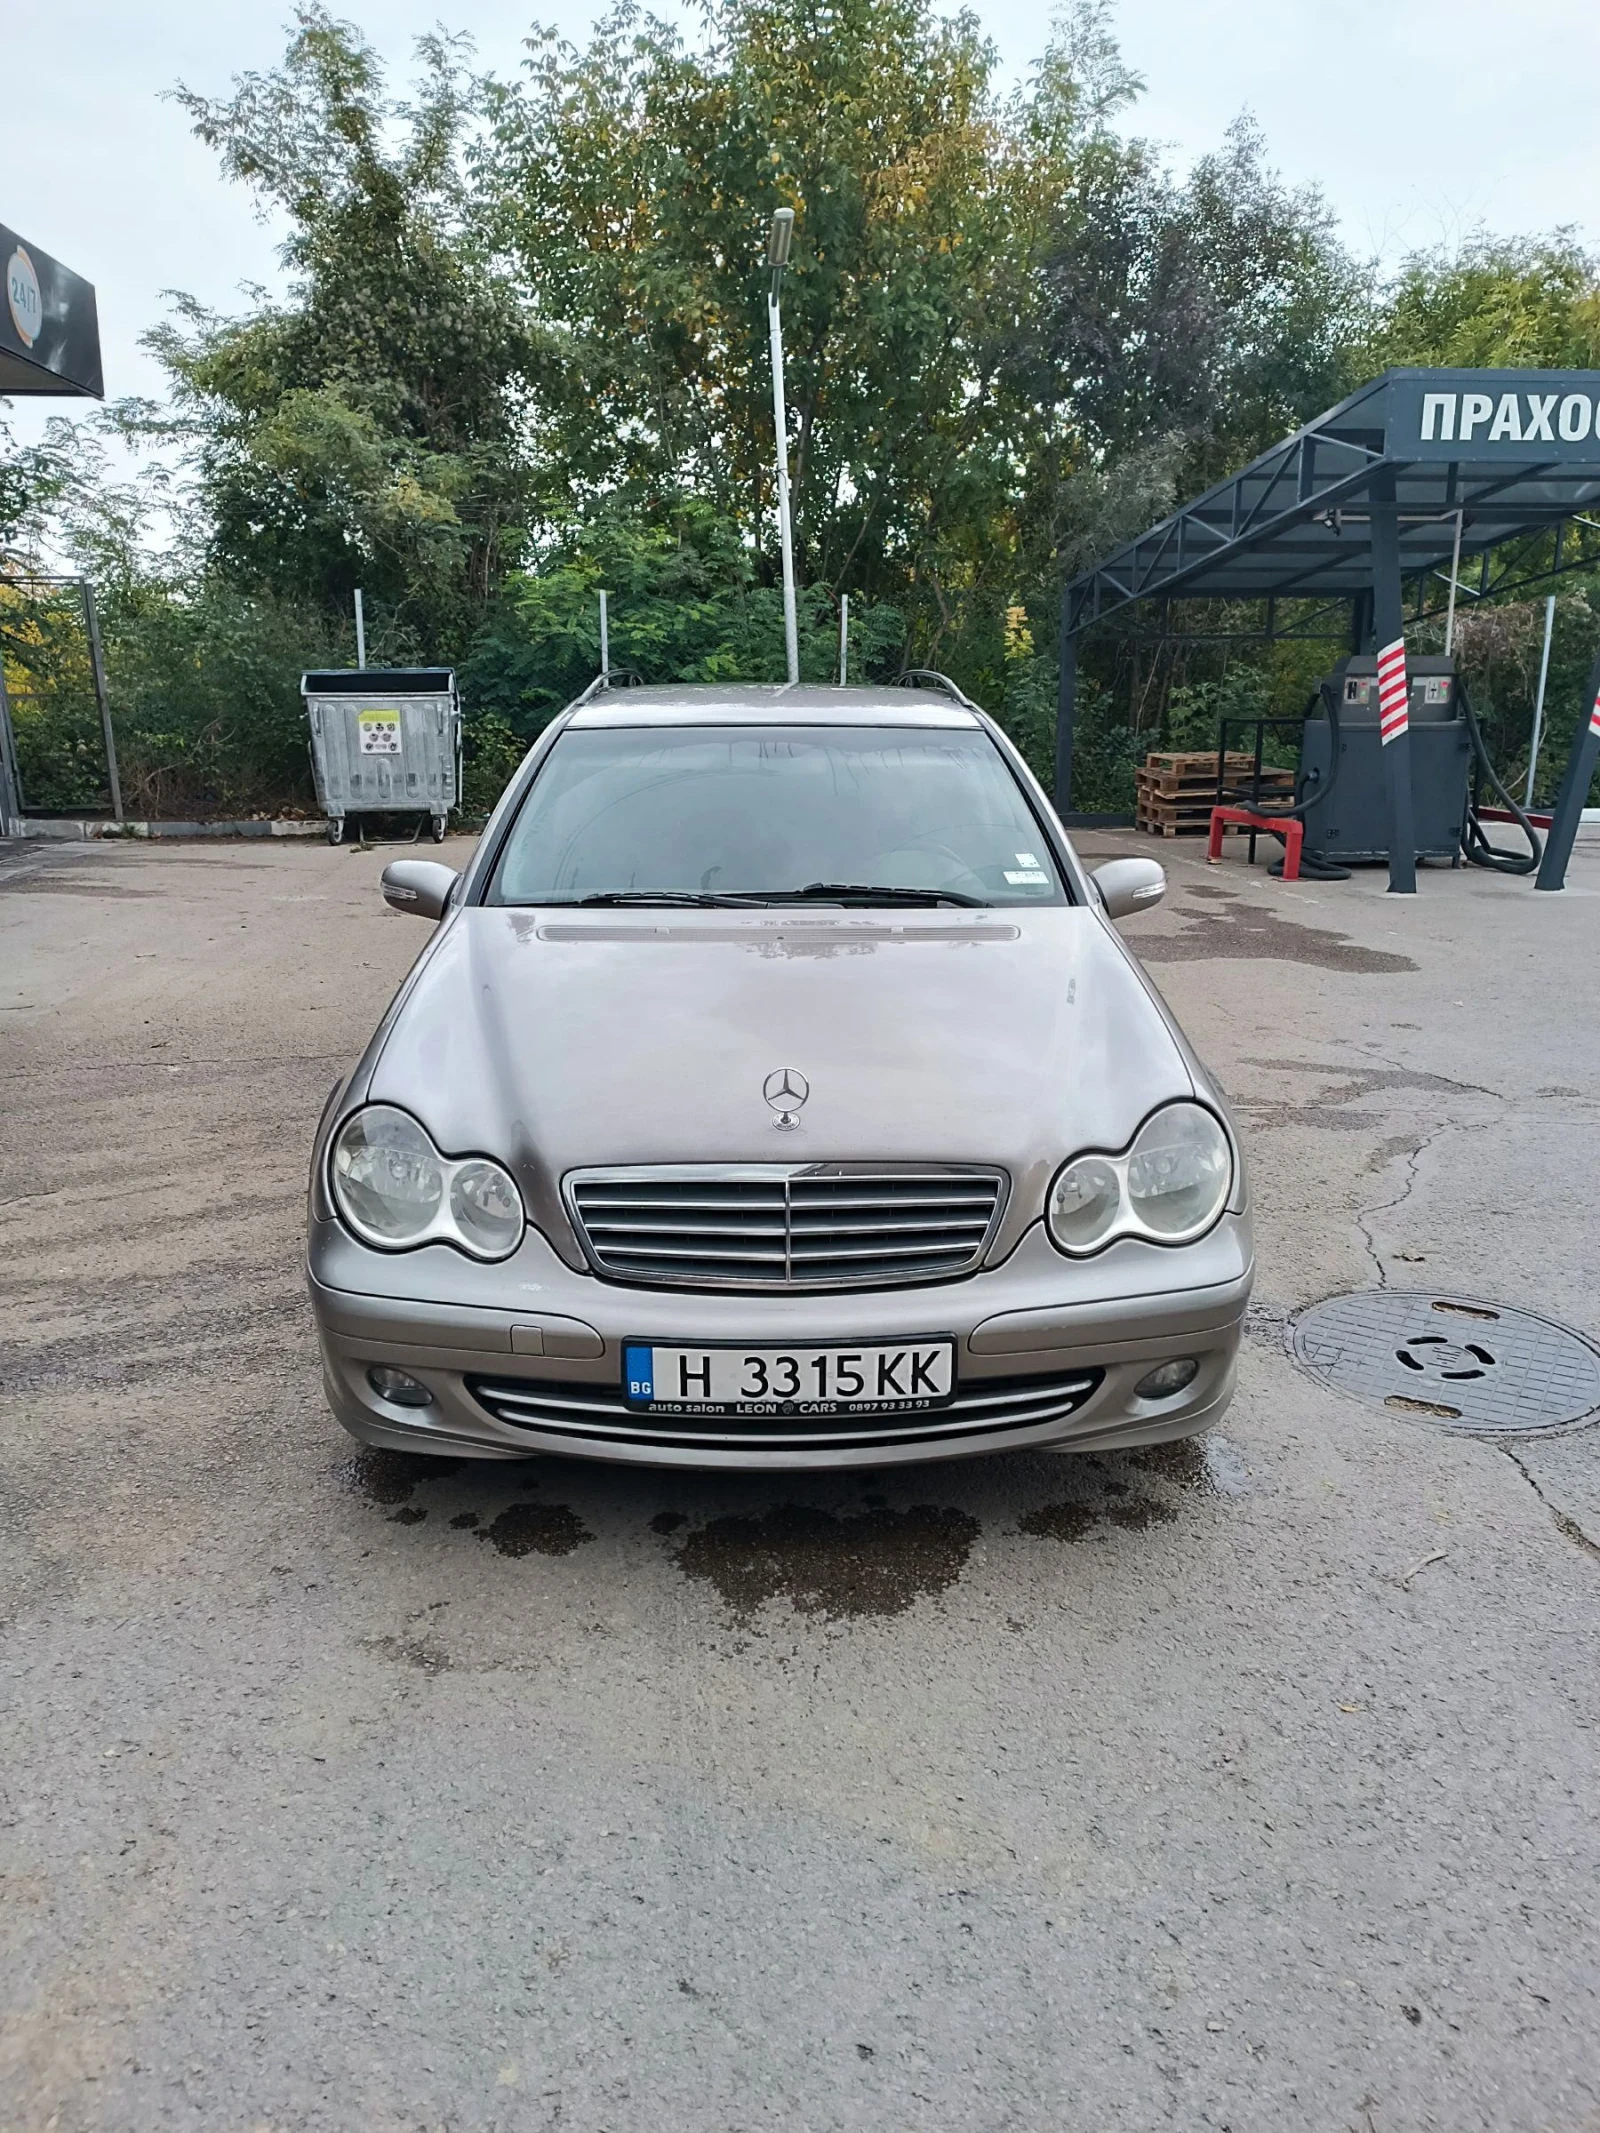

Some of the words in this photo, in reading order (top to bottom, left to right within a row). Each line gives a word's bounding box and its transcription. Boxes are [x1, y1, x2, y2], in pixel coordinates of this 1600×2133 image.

[12, 276, 36, 313] 24/7
[1420, 393, 1600, 442] ПРАХО
[630, 1381, 651, 1394] BG
[679, 1355, 711, 1398] H
[648, 1403, 682, 1412] auto
[686, 1403, 725, 1413] salon
[736, 1403, 777, 1414] LEON
[799, 1402, 837, 1414] CARS
[849, 1402, 878, 1412] 0897
[881, 1401, 895, 1410] 93
[915, 1400, 930, 1408] 93
